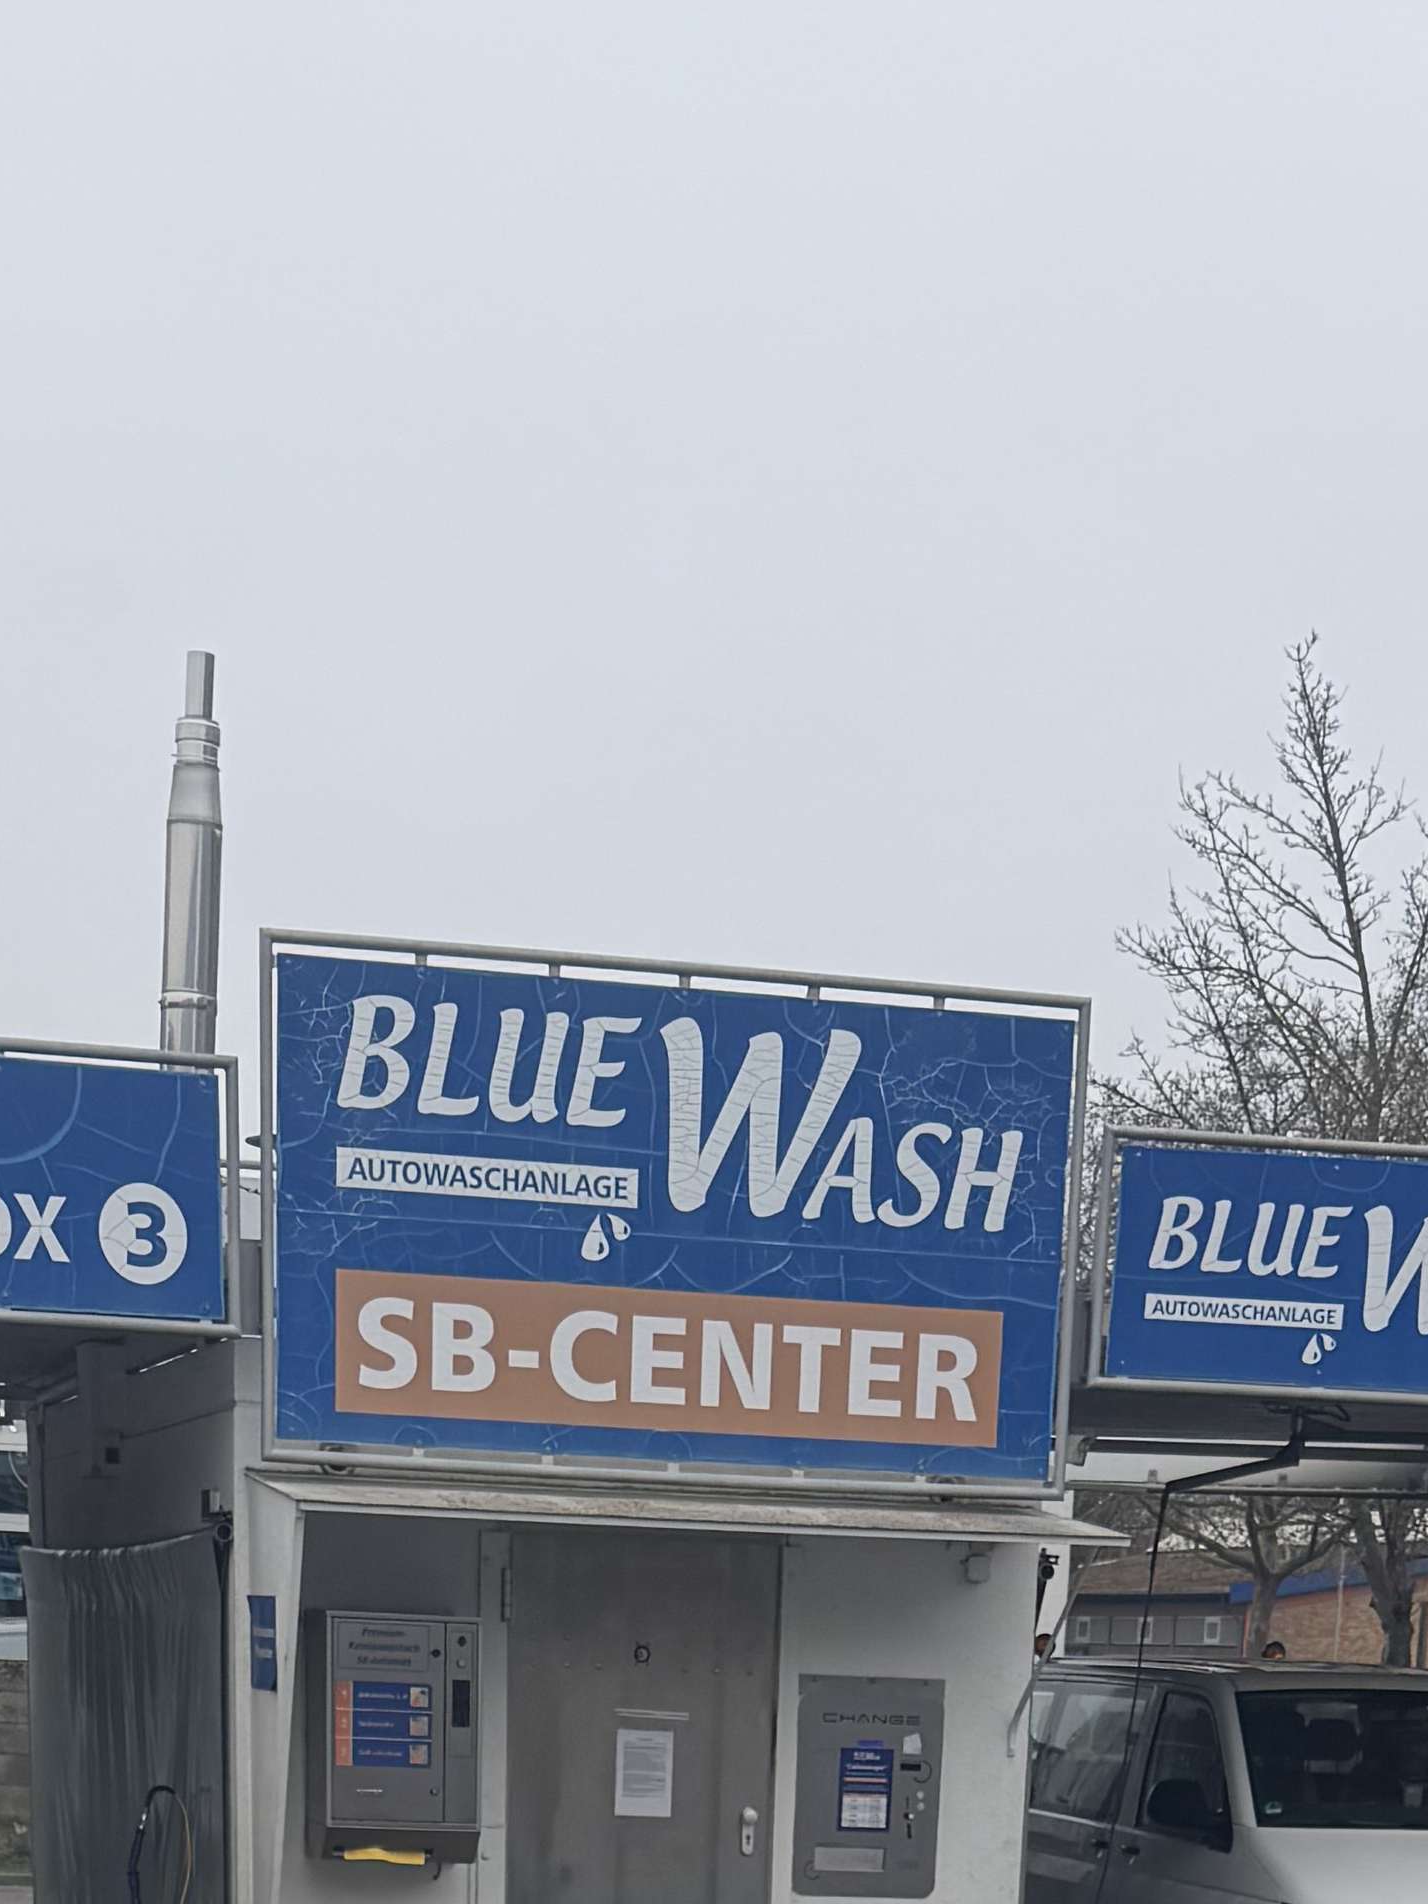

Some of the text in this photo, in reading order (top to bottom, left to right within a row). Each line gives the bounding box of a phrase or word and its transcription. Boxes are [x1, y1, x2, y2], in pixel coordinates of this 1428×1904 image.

[337, 995, 1023, 1232] BLUE WASH
[347, 1157, 629, 1201] AUTOWASCHANLAGE
[126, 1201, 168, 1268] 3
[1148, 1196, 1354, 1278] BLUE
[1152, 1302, 1337, 1326] AUTOWASCHANLAGE
[357, 1296, 978, 1422] SB-CENTER
[822, 1712, 921, 1726] CHANGE
